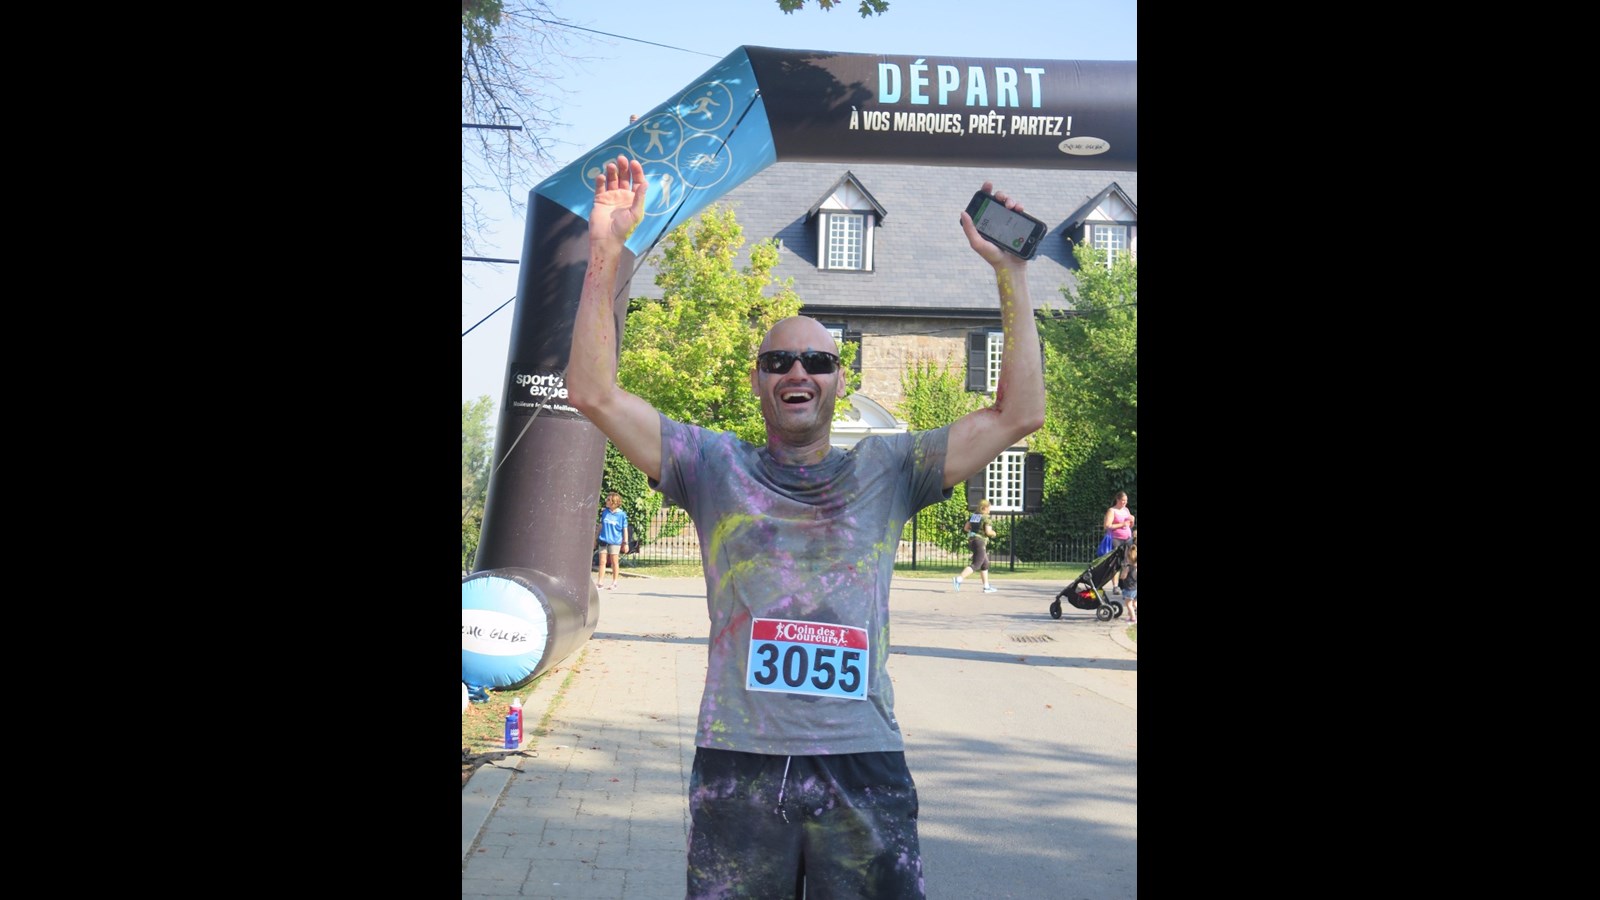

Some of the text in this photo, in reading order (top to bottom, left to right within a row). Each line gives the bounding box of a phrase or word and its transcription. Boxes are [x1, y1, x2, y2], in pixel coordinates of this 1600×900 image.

[878, 59, 1046, 108] DÉPART
[849, 105, 859, 130] À
[863, 111, 891, 131] VOS
[893, 112, 965, 137] MARQUES,
[968, 109, 1008, 138] PRÊT,
[1010, 115, 1064, 136] PARTEZ
[516, 374, 564, 388] sports
[784, 623, 835, 640] Coin des
[754, 643, 861, 693] 3055
